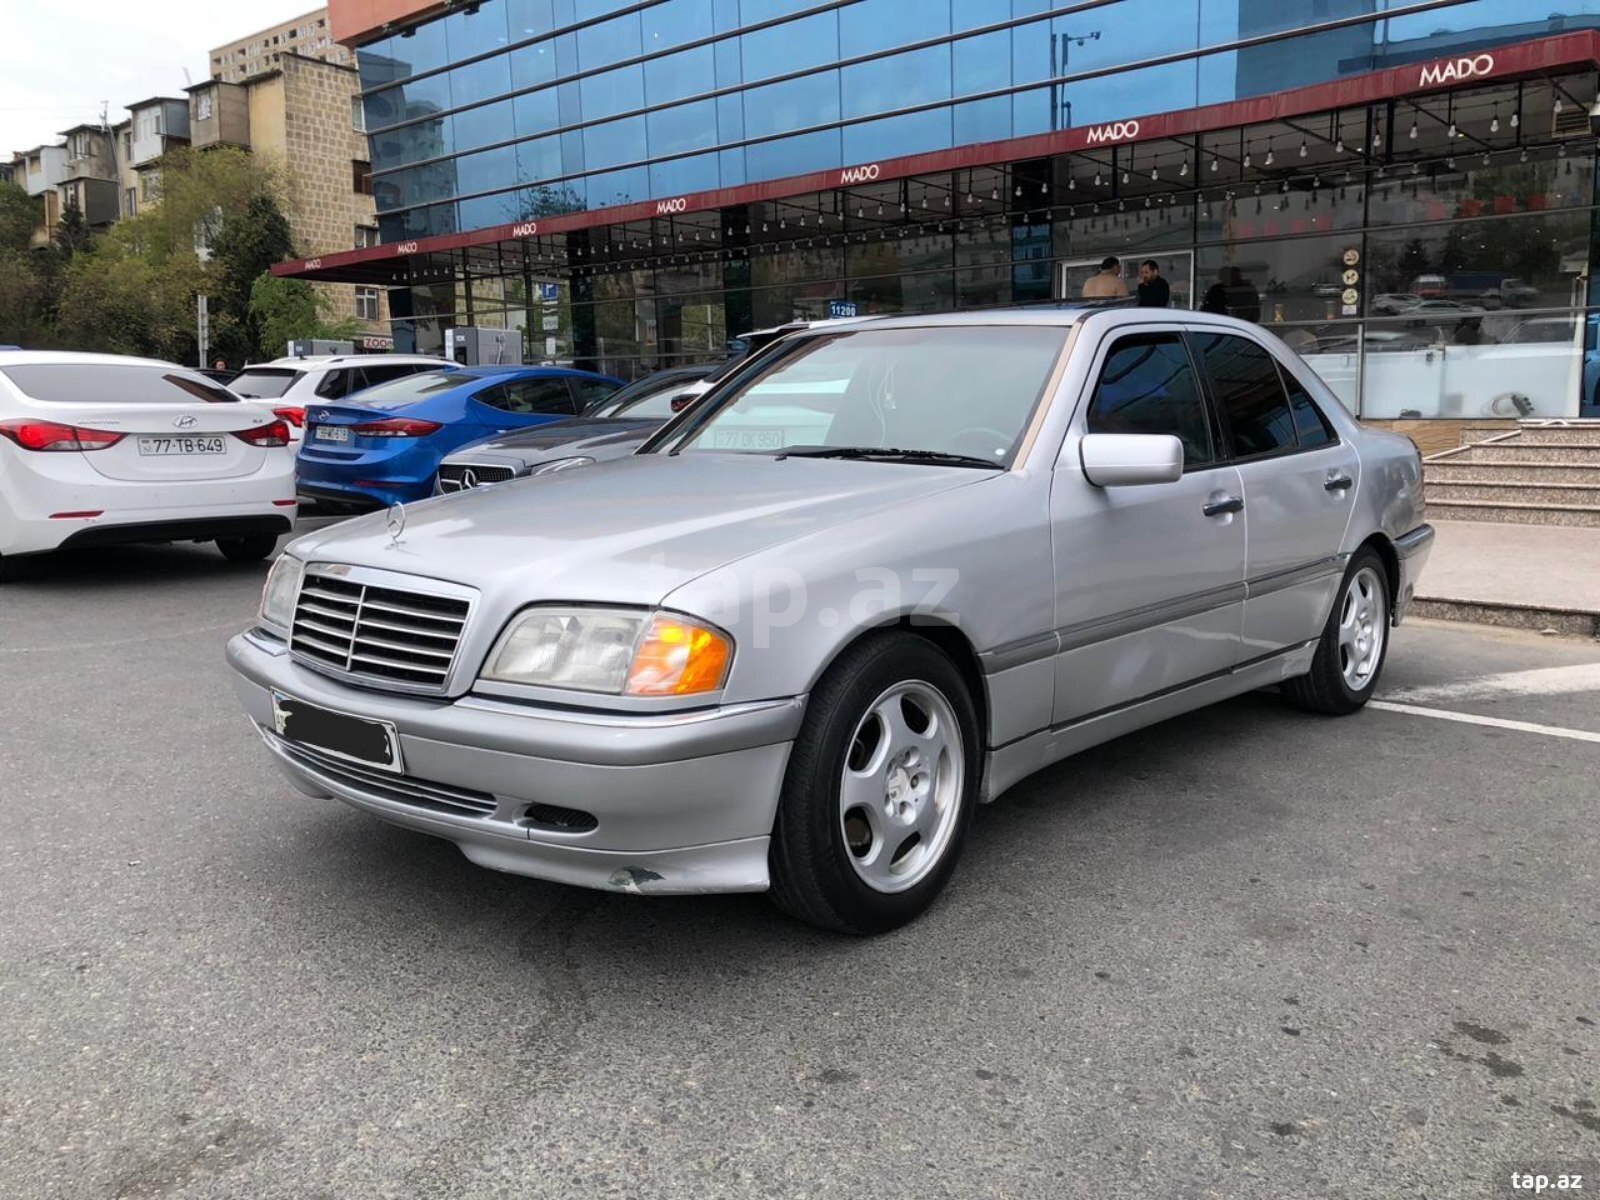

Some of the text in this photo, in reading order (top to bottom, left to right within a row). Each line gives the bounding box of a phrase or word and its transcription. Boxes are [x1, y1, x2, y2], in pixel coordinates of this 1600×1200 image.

[1419, 54, 1494, 87] MADO
[1086, 120, 1140, 144] MADO
[840, 164, 880, 185] MADO
[656, 198, 686, 214] MADO
[513, 222, 537, 237] MADO
[397, 241, 418, 254] MADO
